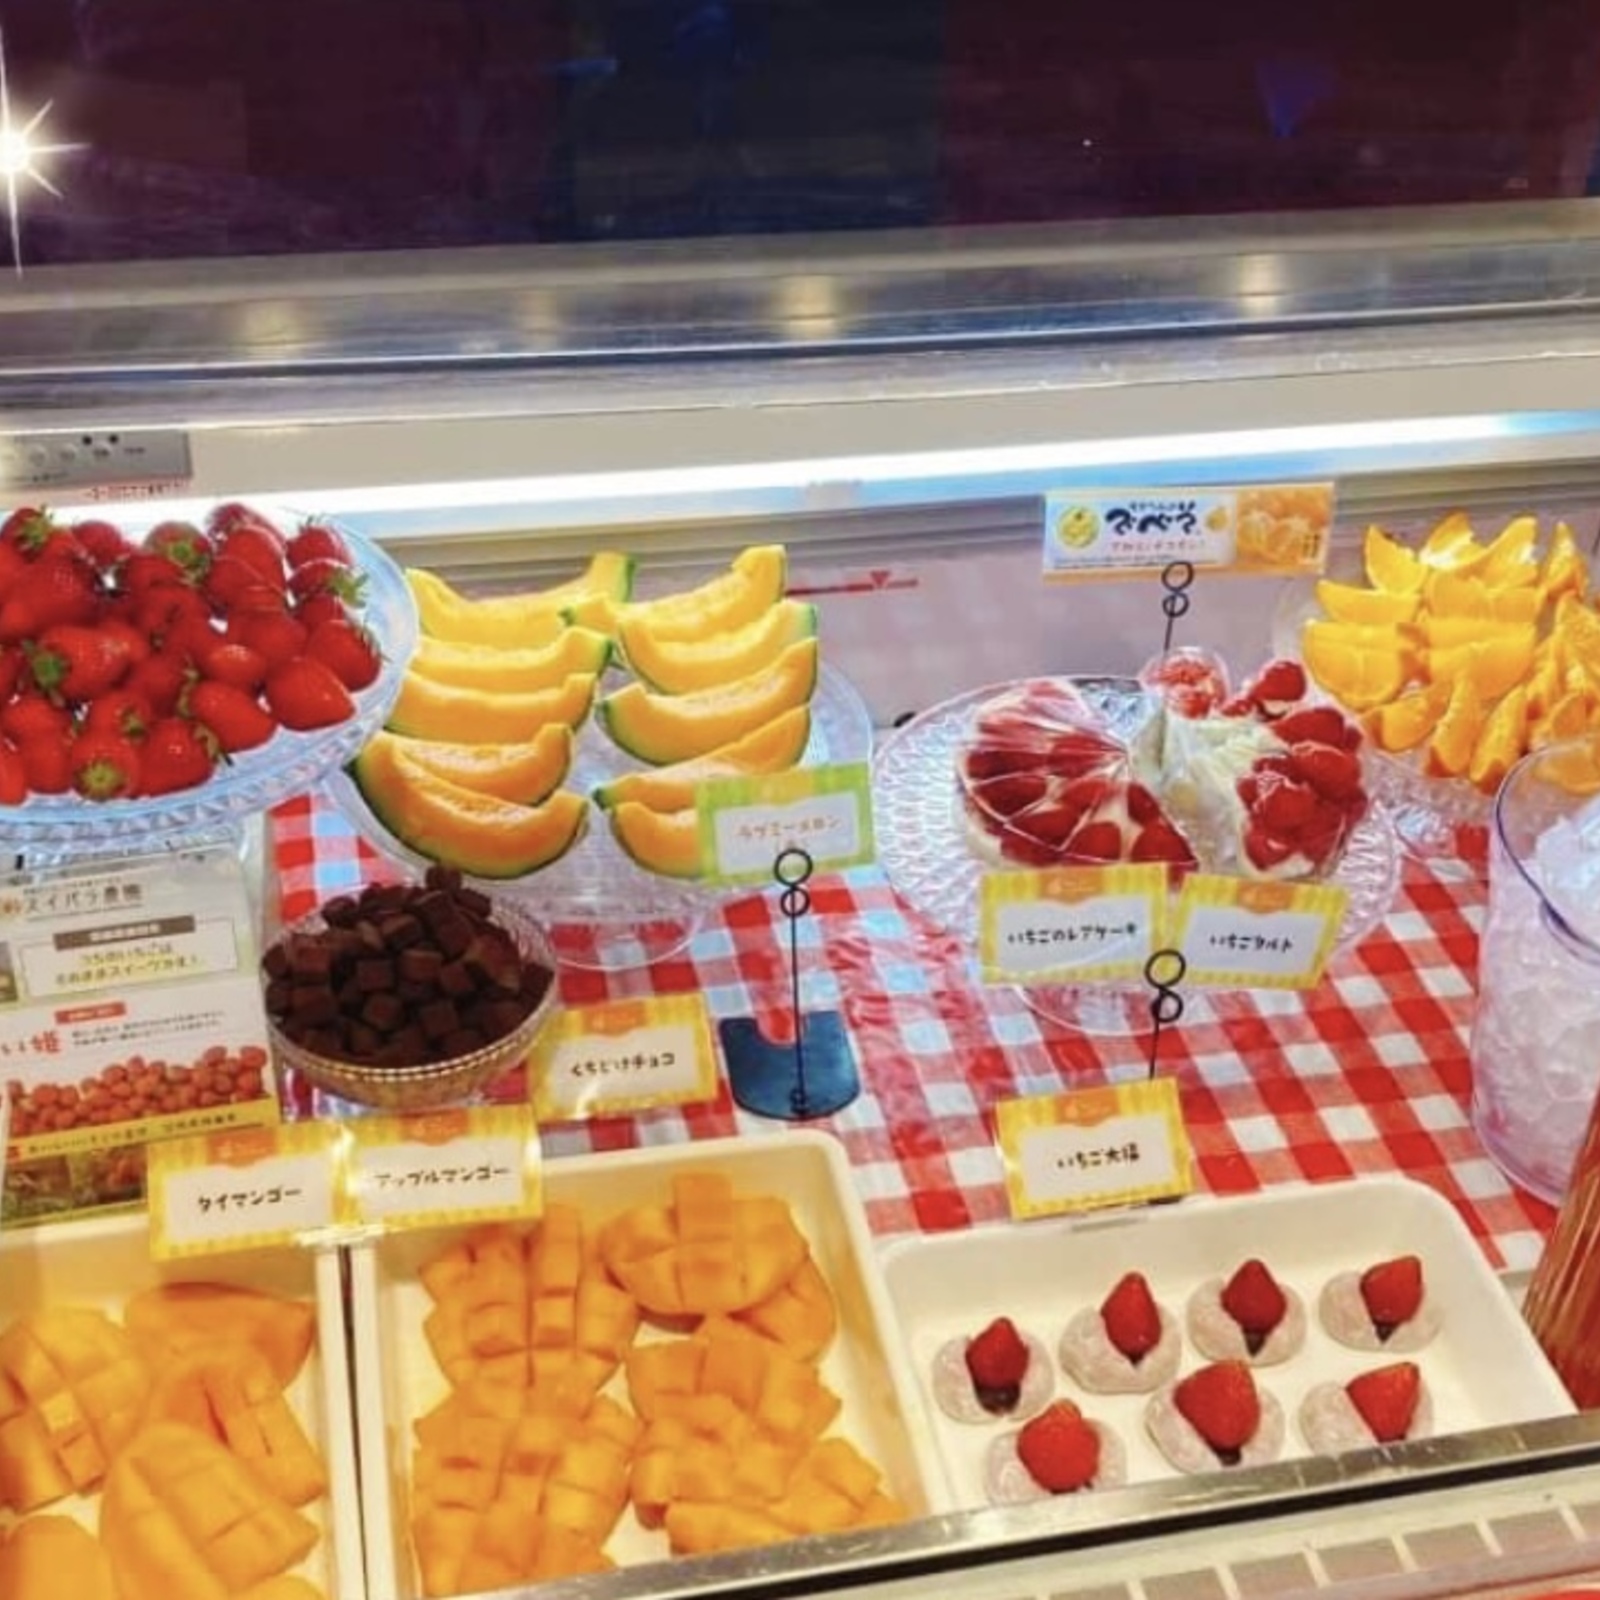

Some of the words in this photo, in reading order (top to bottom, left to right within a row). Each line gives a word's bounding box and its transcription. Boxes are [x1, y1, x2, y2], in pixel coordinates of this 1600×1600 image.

[1209, 933, 1293, 952] いちごタルト
[571, 1052, 676, 1078] くちどけチョコ
[1056, 1142, 1141, 1170] いちご大福
[374, 1162, 510, 1187] アップルマンゴー
[198, 1186, 302, 1213] タイマンゴー
